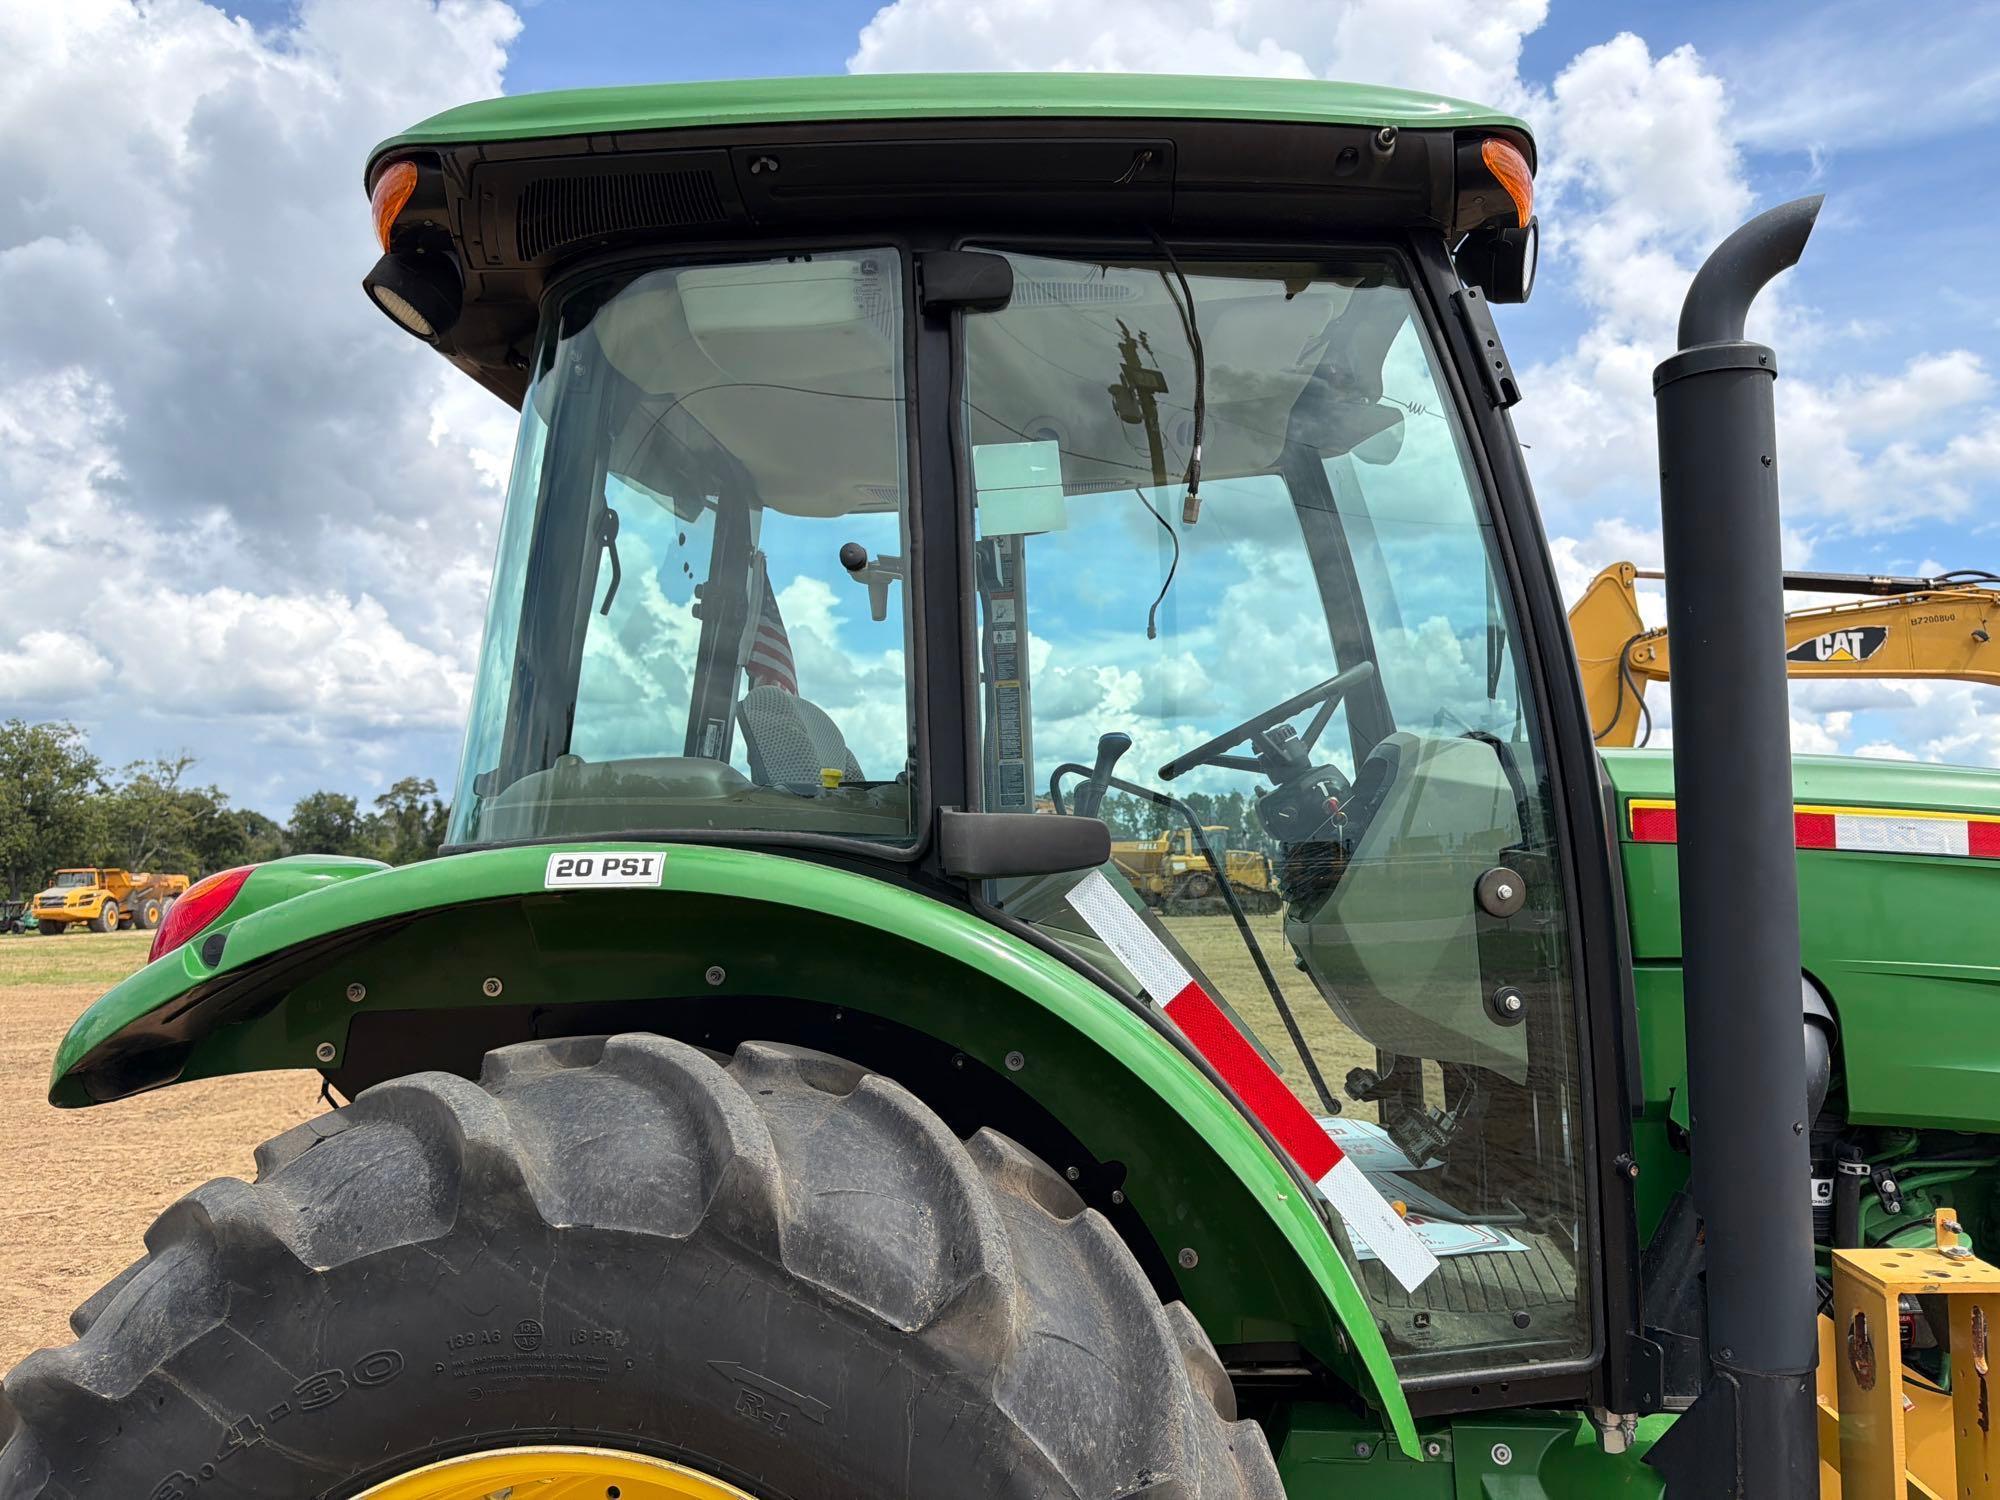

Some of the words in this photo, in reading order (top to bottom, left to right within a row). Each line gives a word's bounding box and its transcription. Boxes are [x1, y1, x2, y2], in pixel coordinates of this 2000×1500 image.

[1815, 631, 1864, 661] CAT
[556, 858, 594, 878] 20
[601, 857, 654, 877] PSI
